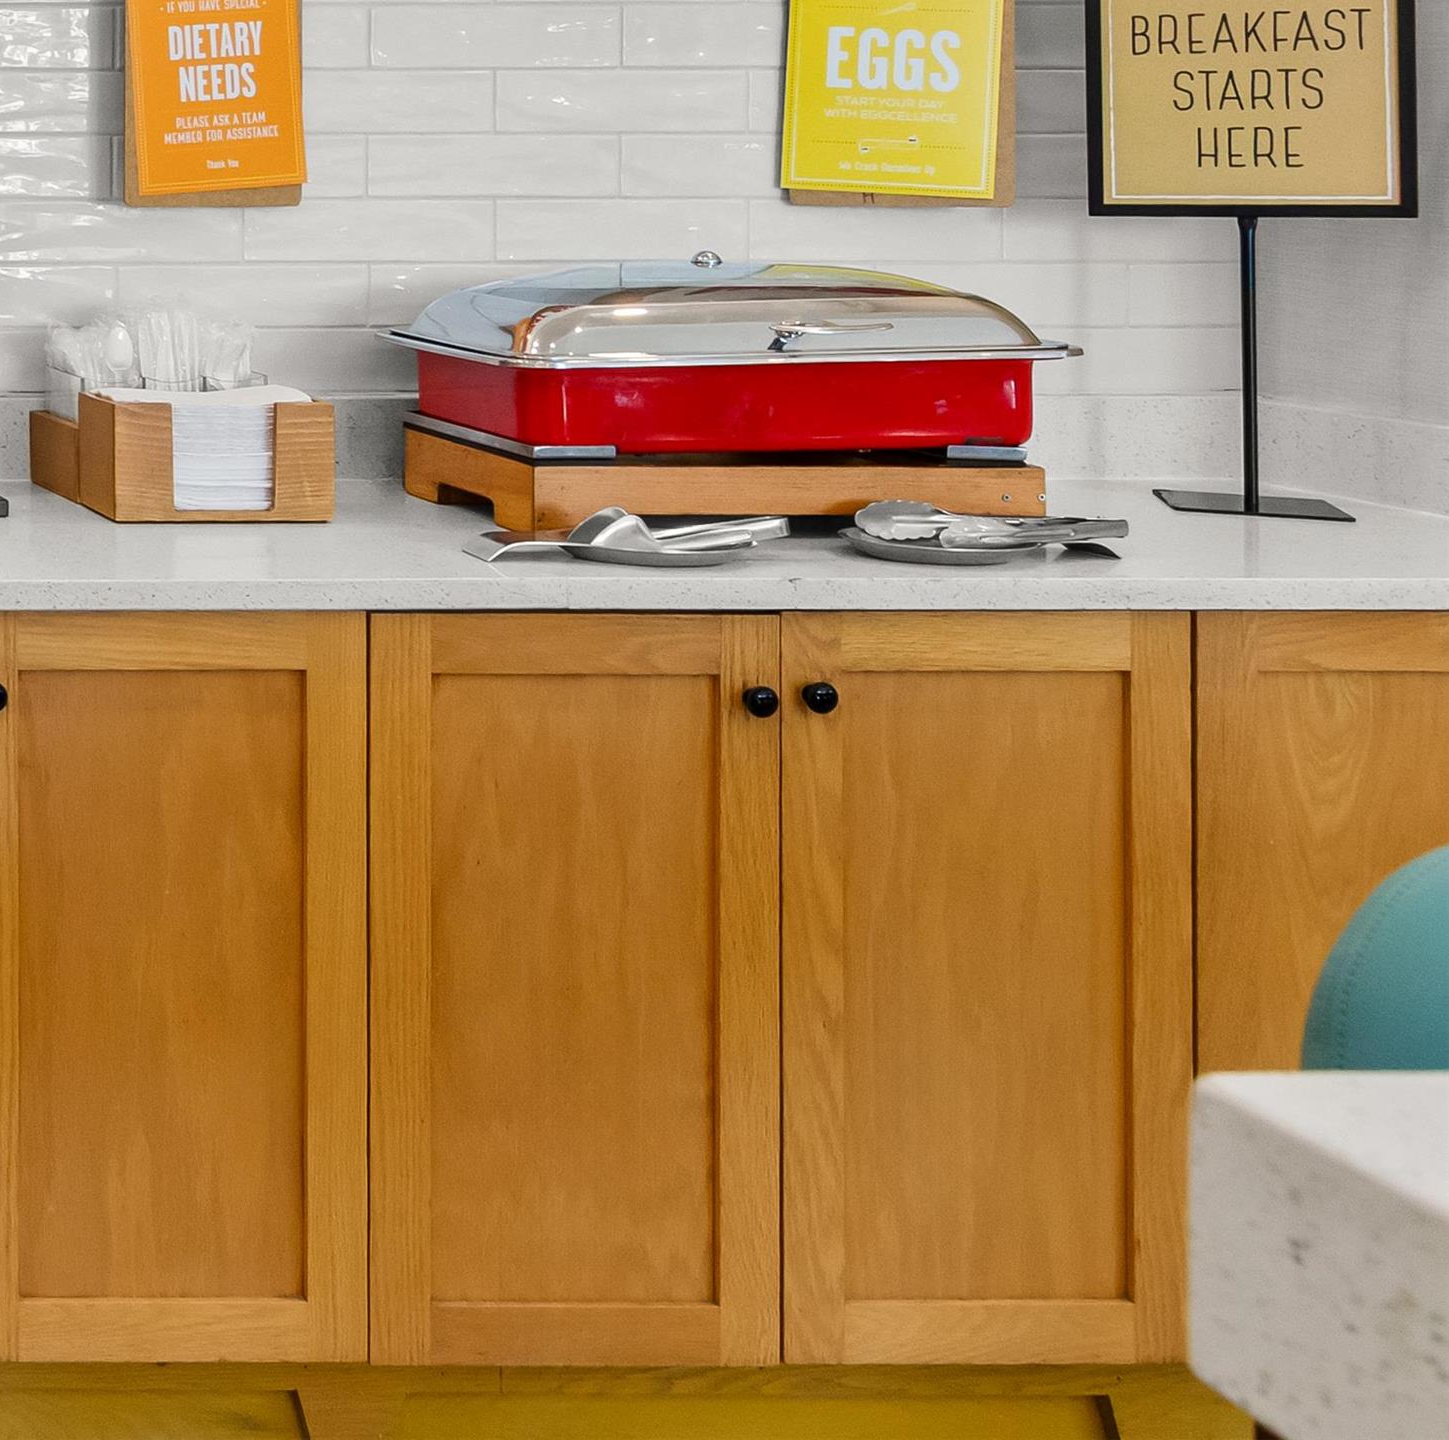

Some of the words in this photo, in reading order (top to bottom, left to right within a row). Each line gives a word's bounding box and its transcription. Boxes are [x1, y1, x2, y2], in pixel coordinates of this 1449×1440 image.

[166, 1, 176, 13] IF
[177, 0, 195, 13] YOU
[199, 0, 221, 11] HAVE
[168, 20, 263, 61] DIETARY
[1130, 7, 1372, 57] BREAKFAST
[825, 26, 962, 93] EGGS
[179, 62, 257, 102] NEEDS
[835, 95, 877, 106] START
[878, 98, 916, 107] YOUR
[918, 100, 943, 109] DAY
[1171, 67, 1325, 113] STARTS
[164, 131, 203, 145] MEMBER
[206, 129, 223, 142] FOR
[226, 125, 279, 140] ASSISTANCE
[176, 115, 209, 129] PLEASE
[212, 114, 230, 126] ASK
[232, 113, 239, 125] A
[241, 111, 266, 124] TEAM
[824, 108, 858, 118] WITH
[860, 110, 958, 123] EGGCELLENCE
[1196, 125, 1305, 169] HERE
